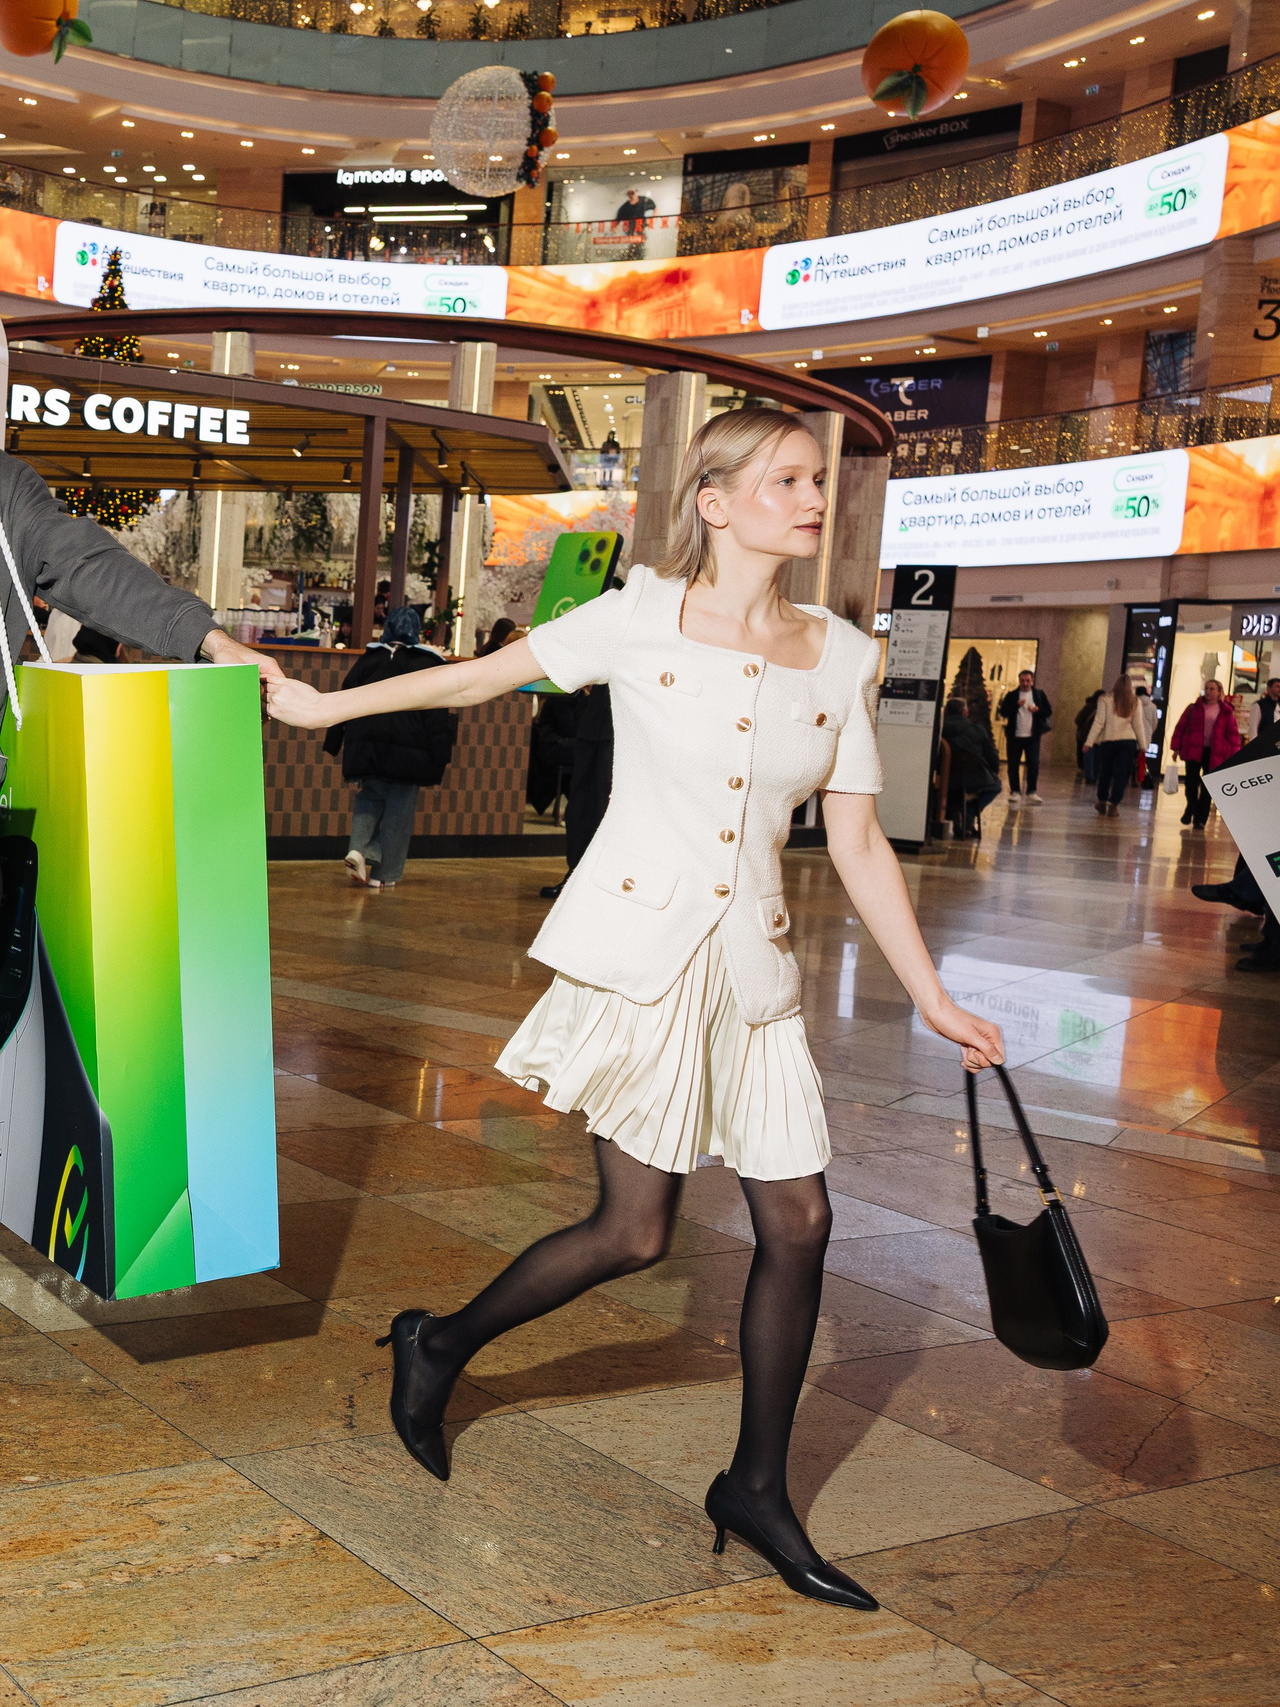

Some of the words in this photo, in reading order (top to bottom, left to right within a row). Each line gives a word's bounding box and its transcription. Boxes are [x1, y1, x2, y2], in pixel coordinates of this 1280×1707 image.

[336, 168, 406, 185] lamoda
[410, 168, 448, 185] spo
[927, 218, 984, 244] Самый
[987, 197, 1059, 232] большой
[1064, 186, 1116, 211] выбор
[925, 243, 995, 268] квартир,
[997, 229, 1049, 253] домов
[1053, 224, 1062, 238] и
[1066, 204, 1124, 235] отелей
[204, 256, 259, 277] Самый
[262, 263, 334, 283] большой
[338, 271, 391, 289] выбор
[814, 257, 907, 284] Путешествия
[816, 253, 849, 268] Avito
[203, 278, 270, 300] квартир,
[273, 286, 325, 301] домов
[329, 291, 338, 302] и
[342, 292, 401, 307] отелей
[1253, 299, 1280, 341] 3
[5, 384, 71, 426] RS
[83, 392, 250, 445] COFFEE
[884, 409, 929, 422] ABER
[902, 487, 957, 507] Самый
[960, 480, 1030, 503] большой
[1035, 478, 1084, 498] выбор
[900, 512, 966, 530] квартир,
[970, 507, 1021, 525] домов
[1024, 509, 1033, 520] и
[1037, 499, 1092, 519] отелей
[911, 569, 935, 605] 2
[1240, 773, 1274, 789] СБЕР
